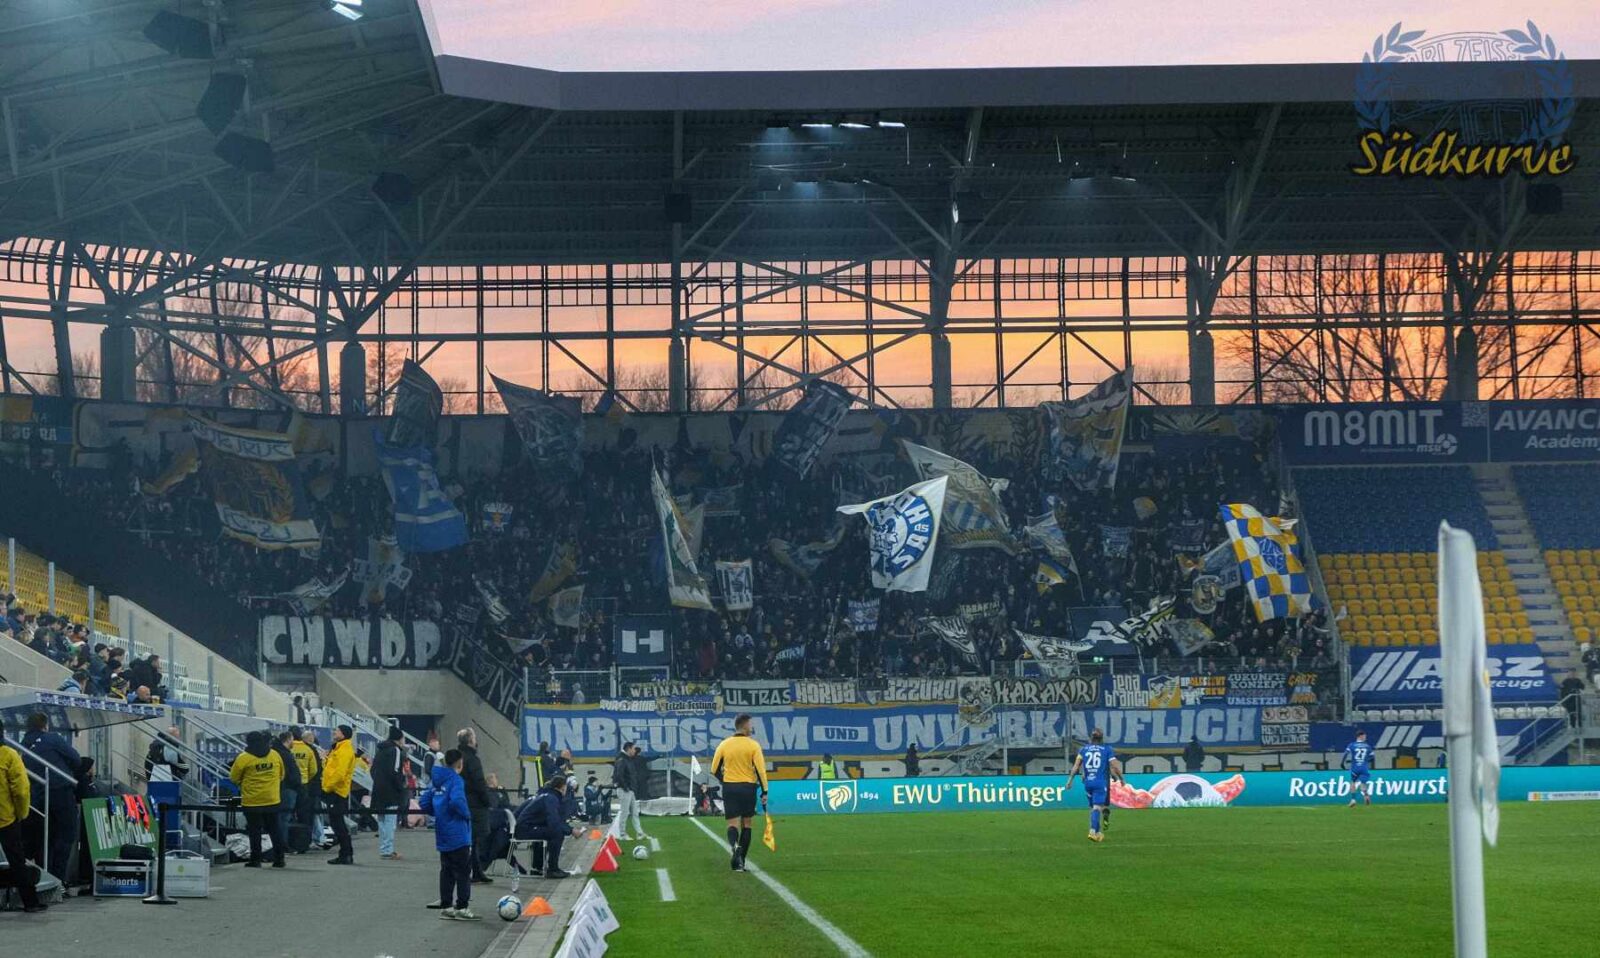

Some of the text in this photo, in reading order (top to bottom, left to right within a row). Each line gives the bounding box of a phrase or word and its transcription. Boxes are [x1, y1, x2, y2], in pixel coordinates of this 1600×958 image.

[1493, 408, 1600, 431] AVANC
[1524, 434, 1600, 452] Academ
[993, 677, 1099, 704] HARAKIRI
[1230, 681, 1285, 689] KONZEPT
[726, 688, 792, 706] ULTRAS
[1227, 697, 1288, 706] UMSETZEN
[824, 727, 859, 740] UND
[1261, 734, 1310, 745] WELCOME
[1085, 751, 1102, 769] 26
[1354, 748, 1368, 760] 27
[796, 791, 879, 800] EWU 1894
[952, 781, 1066, 807] Thüringer
